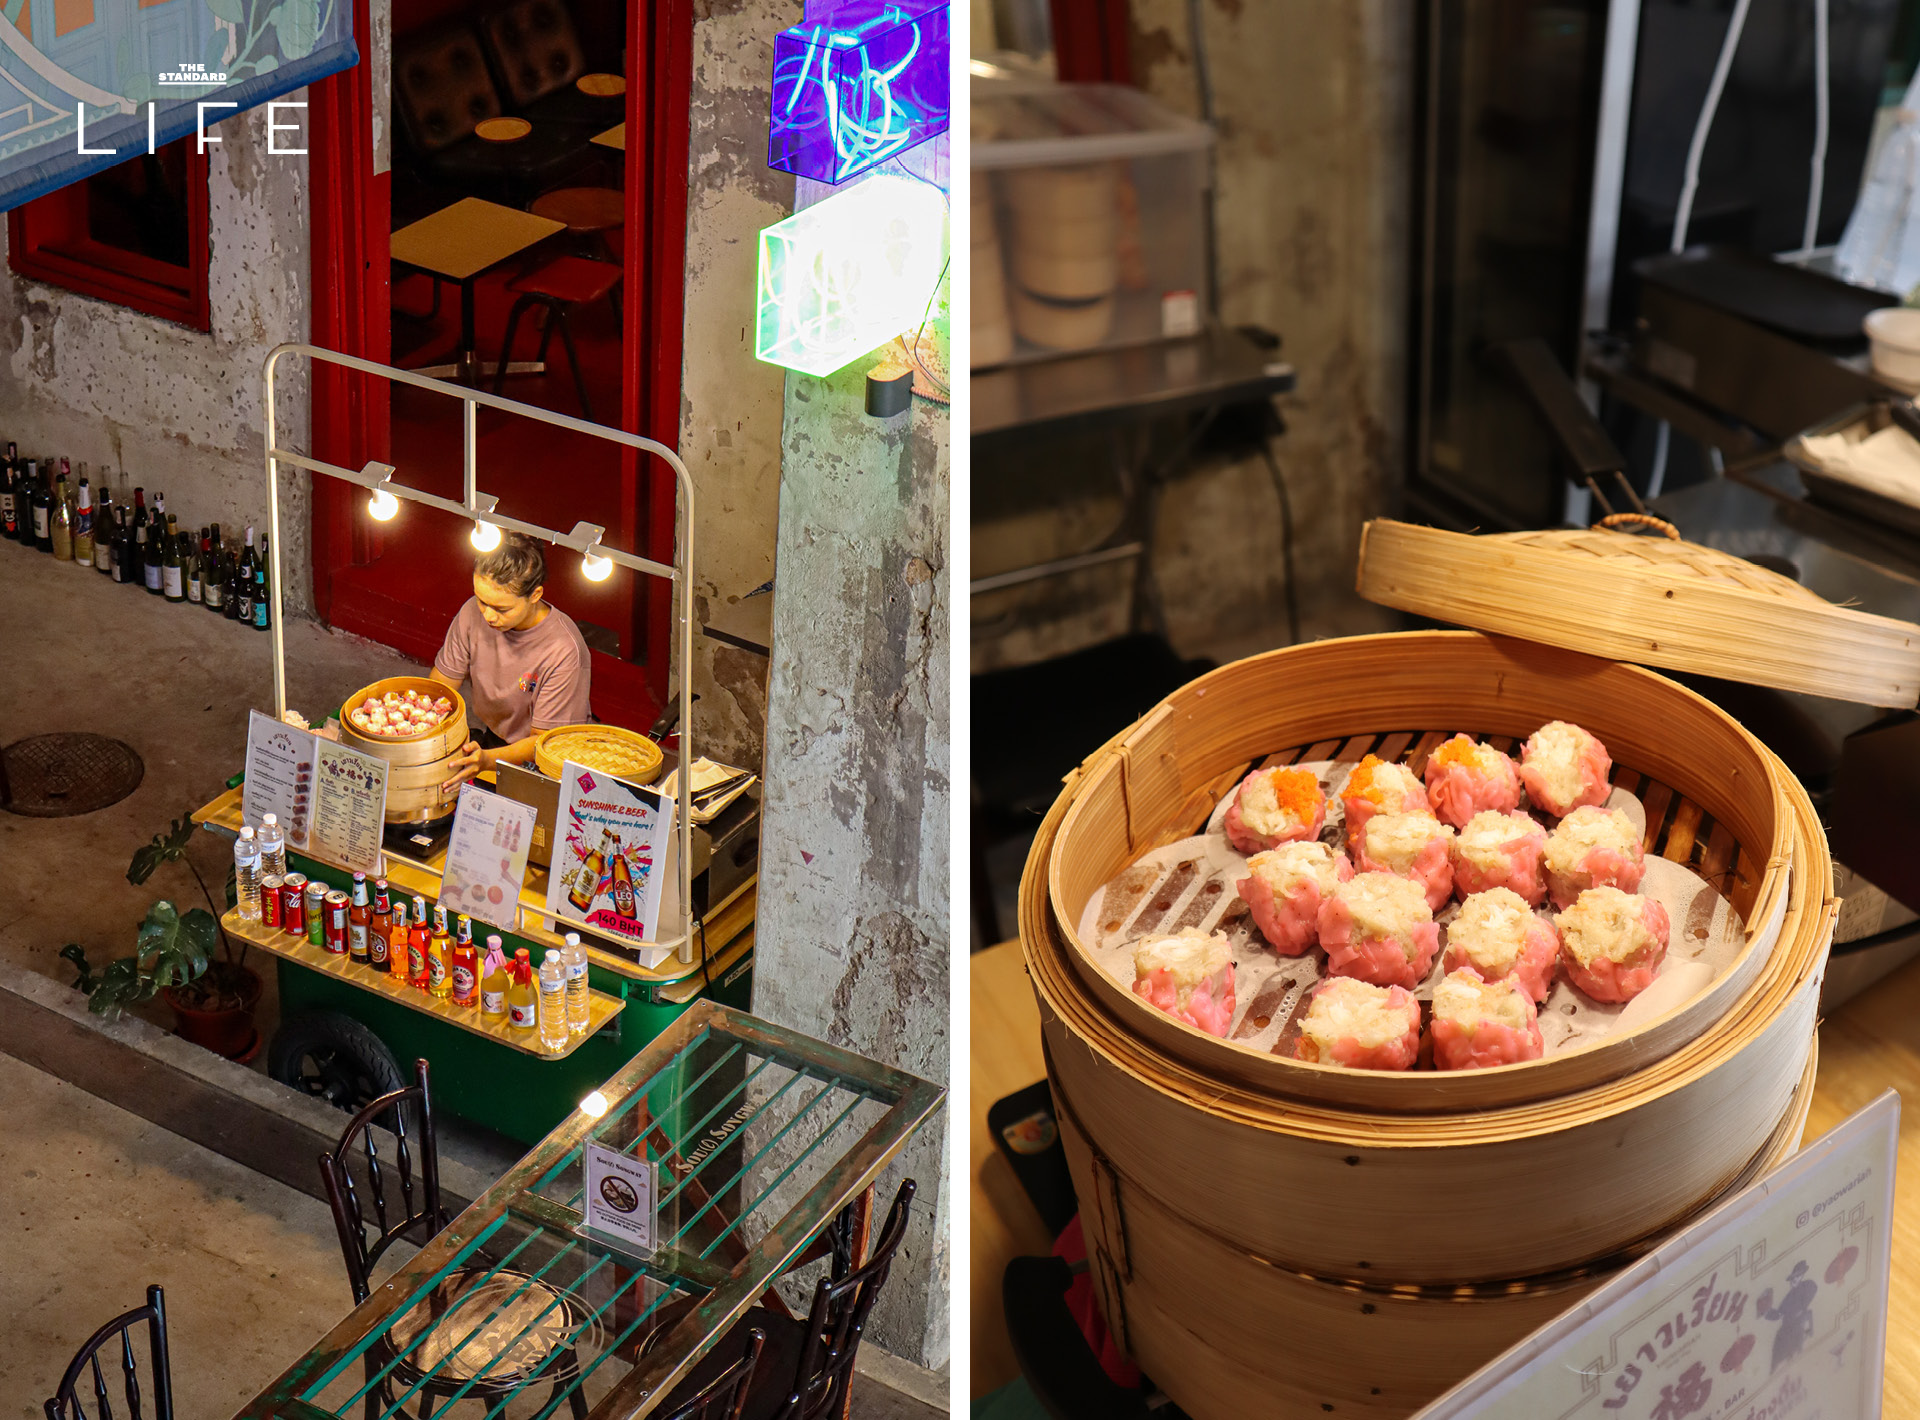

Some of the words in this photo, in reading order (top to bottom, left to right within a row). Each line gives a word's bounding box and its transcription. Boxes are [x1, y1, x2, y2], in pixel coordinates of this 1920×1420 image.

[577, 798, 619, 814] SUNSHINE
[625, 807, 648, 819] BEER
[615, 891, 633, 901] LEO
[598, 911, 617, 927] 140
[619, 920, 644, 936] BHT
[1812, 1167, 1872, 1218] @yaowarian
[1724, 1387, 1746, 1410] BAR
